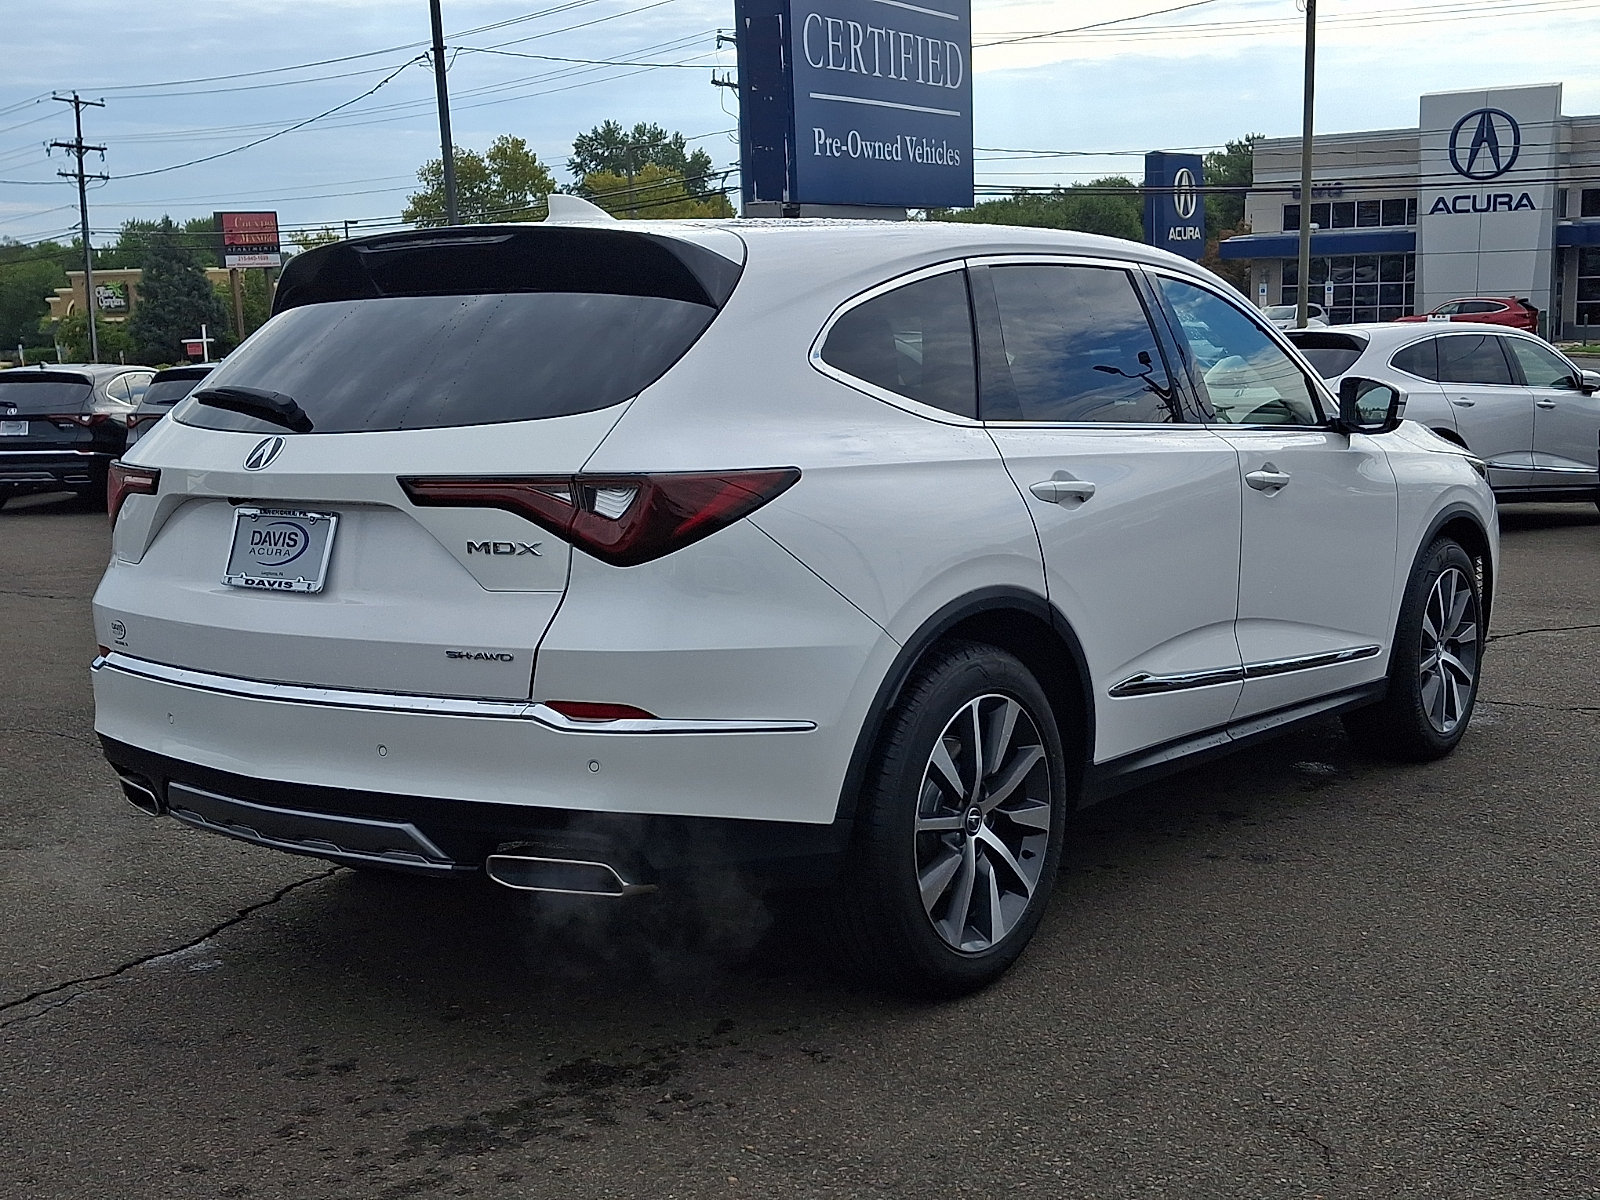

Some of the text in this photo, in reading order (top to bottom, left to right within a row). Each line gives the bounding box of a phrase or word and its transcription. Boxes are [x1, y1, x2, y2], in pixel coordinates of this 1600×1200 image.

[803, 12, 963, 90] CERTIFIED
[813, 127, 961, 167] Pre-Owned Vehicles
[1428, 192, 1536, 215] ACURA
[1168, 226, 1201, 240] ACURA
[250, 530, 299, 548] DAVIS
[249, 547, 291, 557] ACURA
[466, 540, 543, 556] MDX
[244, 579, 294, 589] DAVIS
[445, 650, 514, 662] SH-AWD
